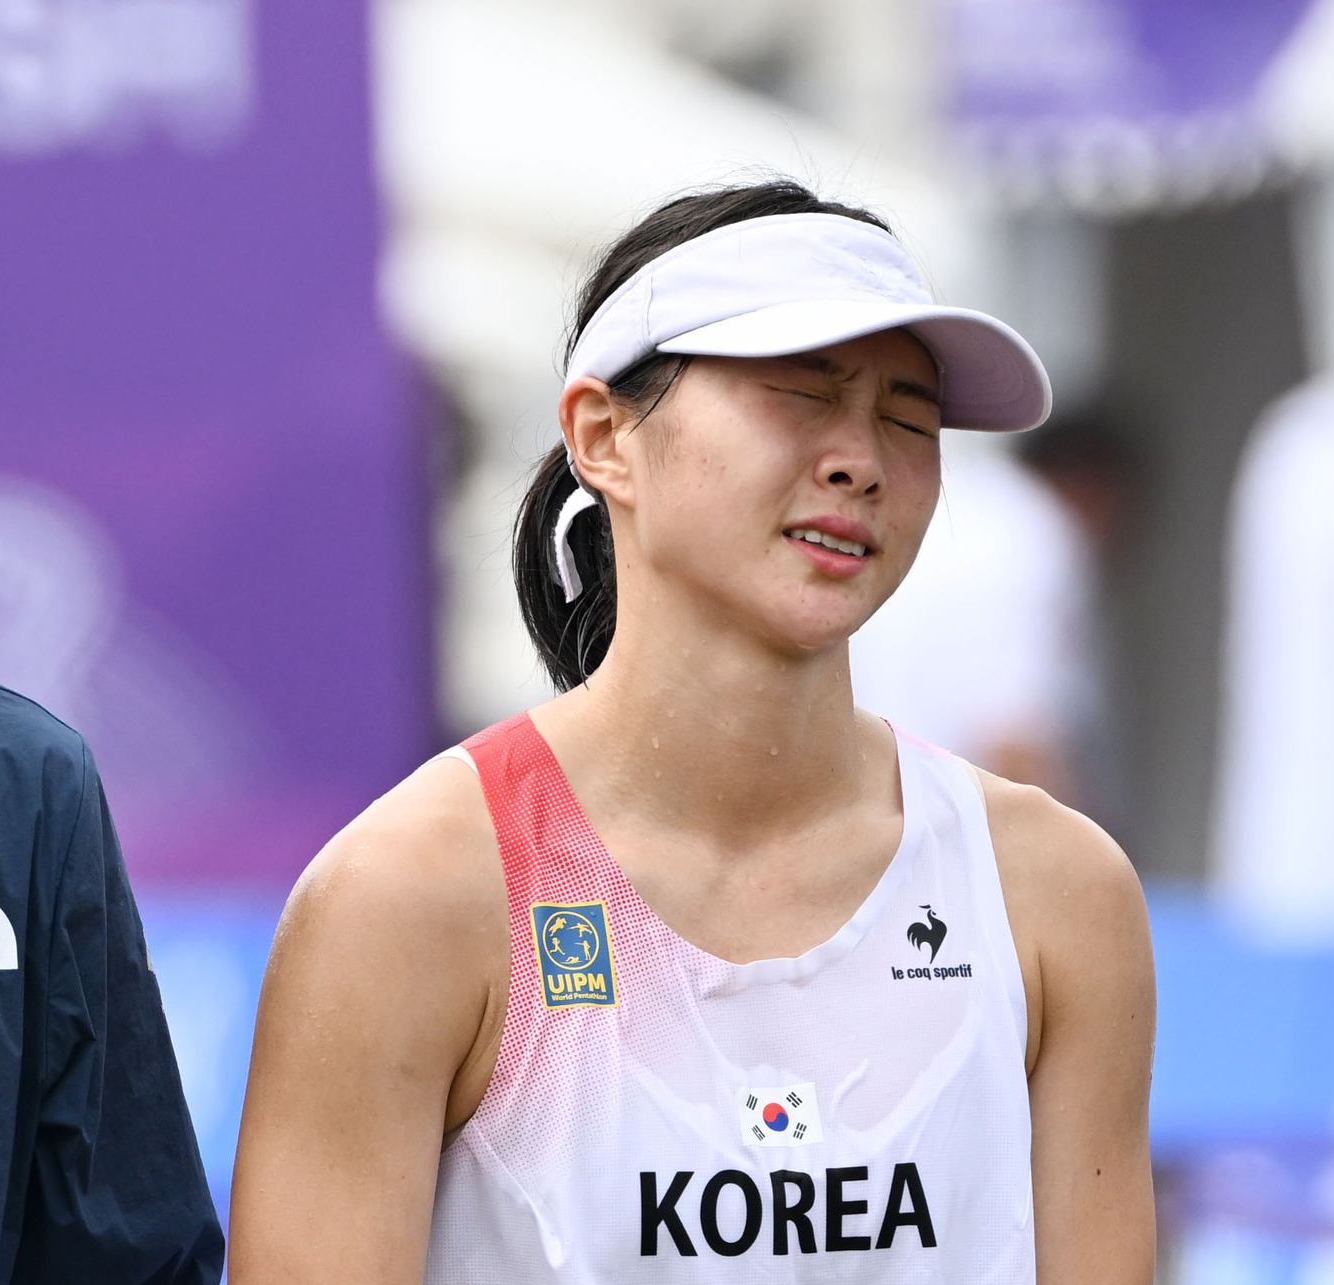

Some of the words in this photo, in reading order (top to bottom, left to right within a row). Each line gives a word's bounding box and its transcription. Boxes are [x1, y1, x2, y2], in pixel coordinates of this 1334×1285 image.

[891, 966, 904, 980] le
[907, 967, 932, 981] coq
[933, 963, 972, 981] sportif
[547, 972, 607, 994] UIPM
[551, 993, 573, 1001] World
[573, 992, 607, 1000] Pentathlon
[639, 1162, 937, 1257] KOREA
